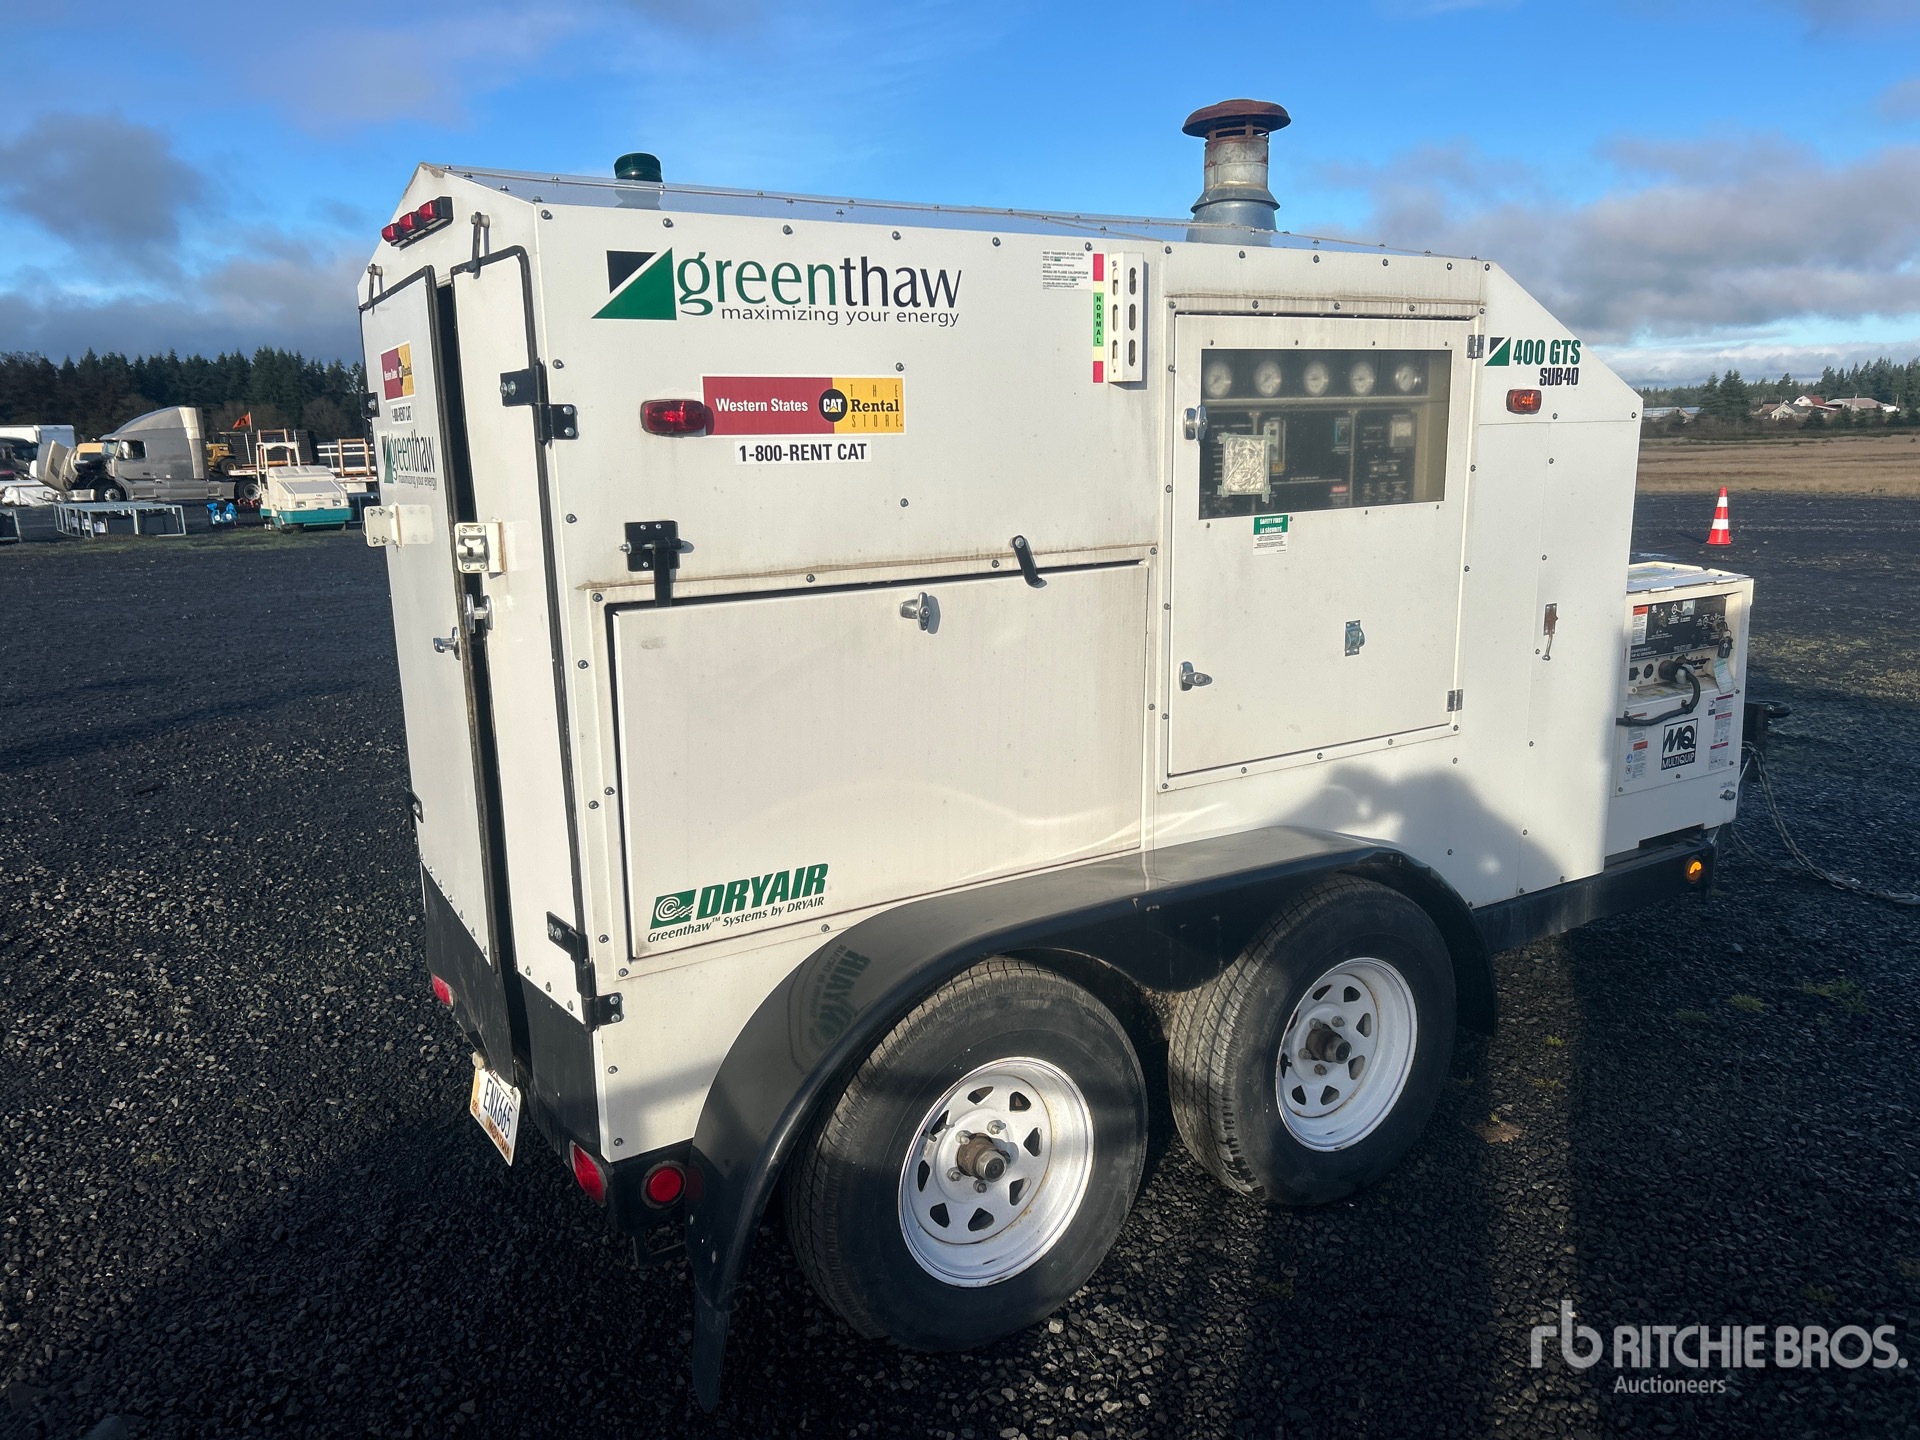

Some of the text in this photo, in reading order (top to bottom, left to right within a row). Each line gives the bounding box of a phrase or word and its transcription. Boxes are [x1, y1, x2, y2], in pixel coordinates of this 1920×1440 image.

[677, 251, 962, 316] greenthaw
[721, 305, 960, 327] maximizing your energy
[1513, 339, 1581, 365] 400 GTS
[1539, 367, 1579, 386] SUB40
[850, 384, 898, 398] THE
[715, 398, 809, 412] Western States
[822, 398, 843, 413] CAT
[850, 399, 900, 412] Rental
[390, 429, 436, 481] greenthaw
[739, 443, 867, 462] 1-800-RENT CAT
[1663, 725, 1696, 753] MQ
[1662, 752, 1695, 769] MULTIQUIP
[696, 863, 829, 920] DRYAIR
[722, 910, 768, 927] Systems
[771, 905, 784, 917] by
[786, 897, 825, 913] DRYAIR
[483, 1077, 513, 1139] ENX665
